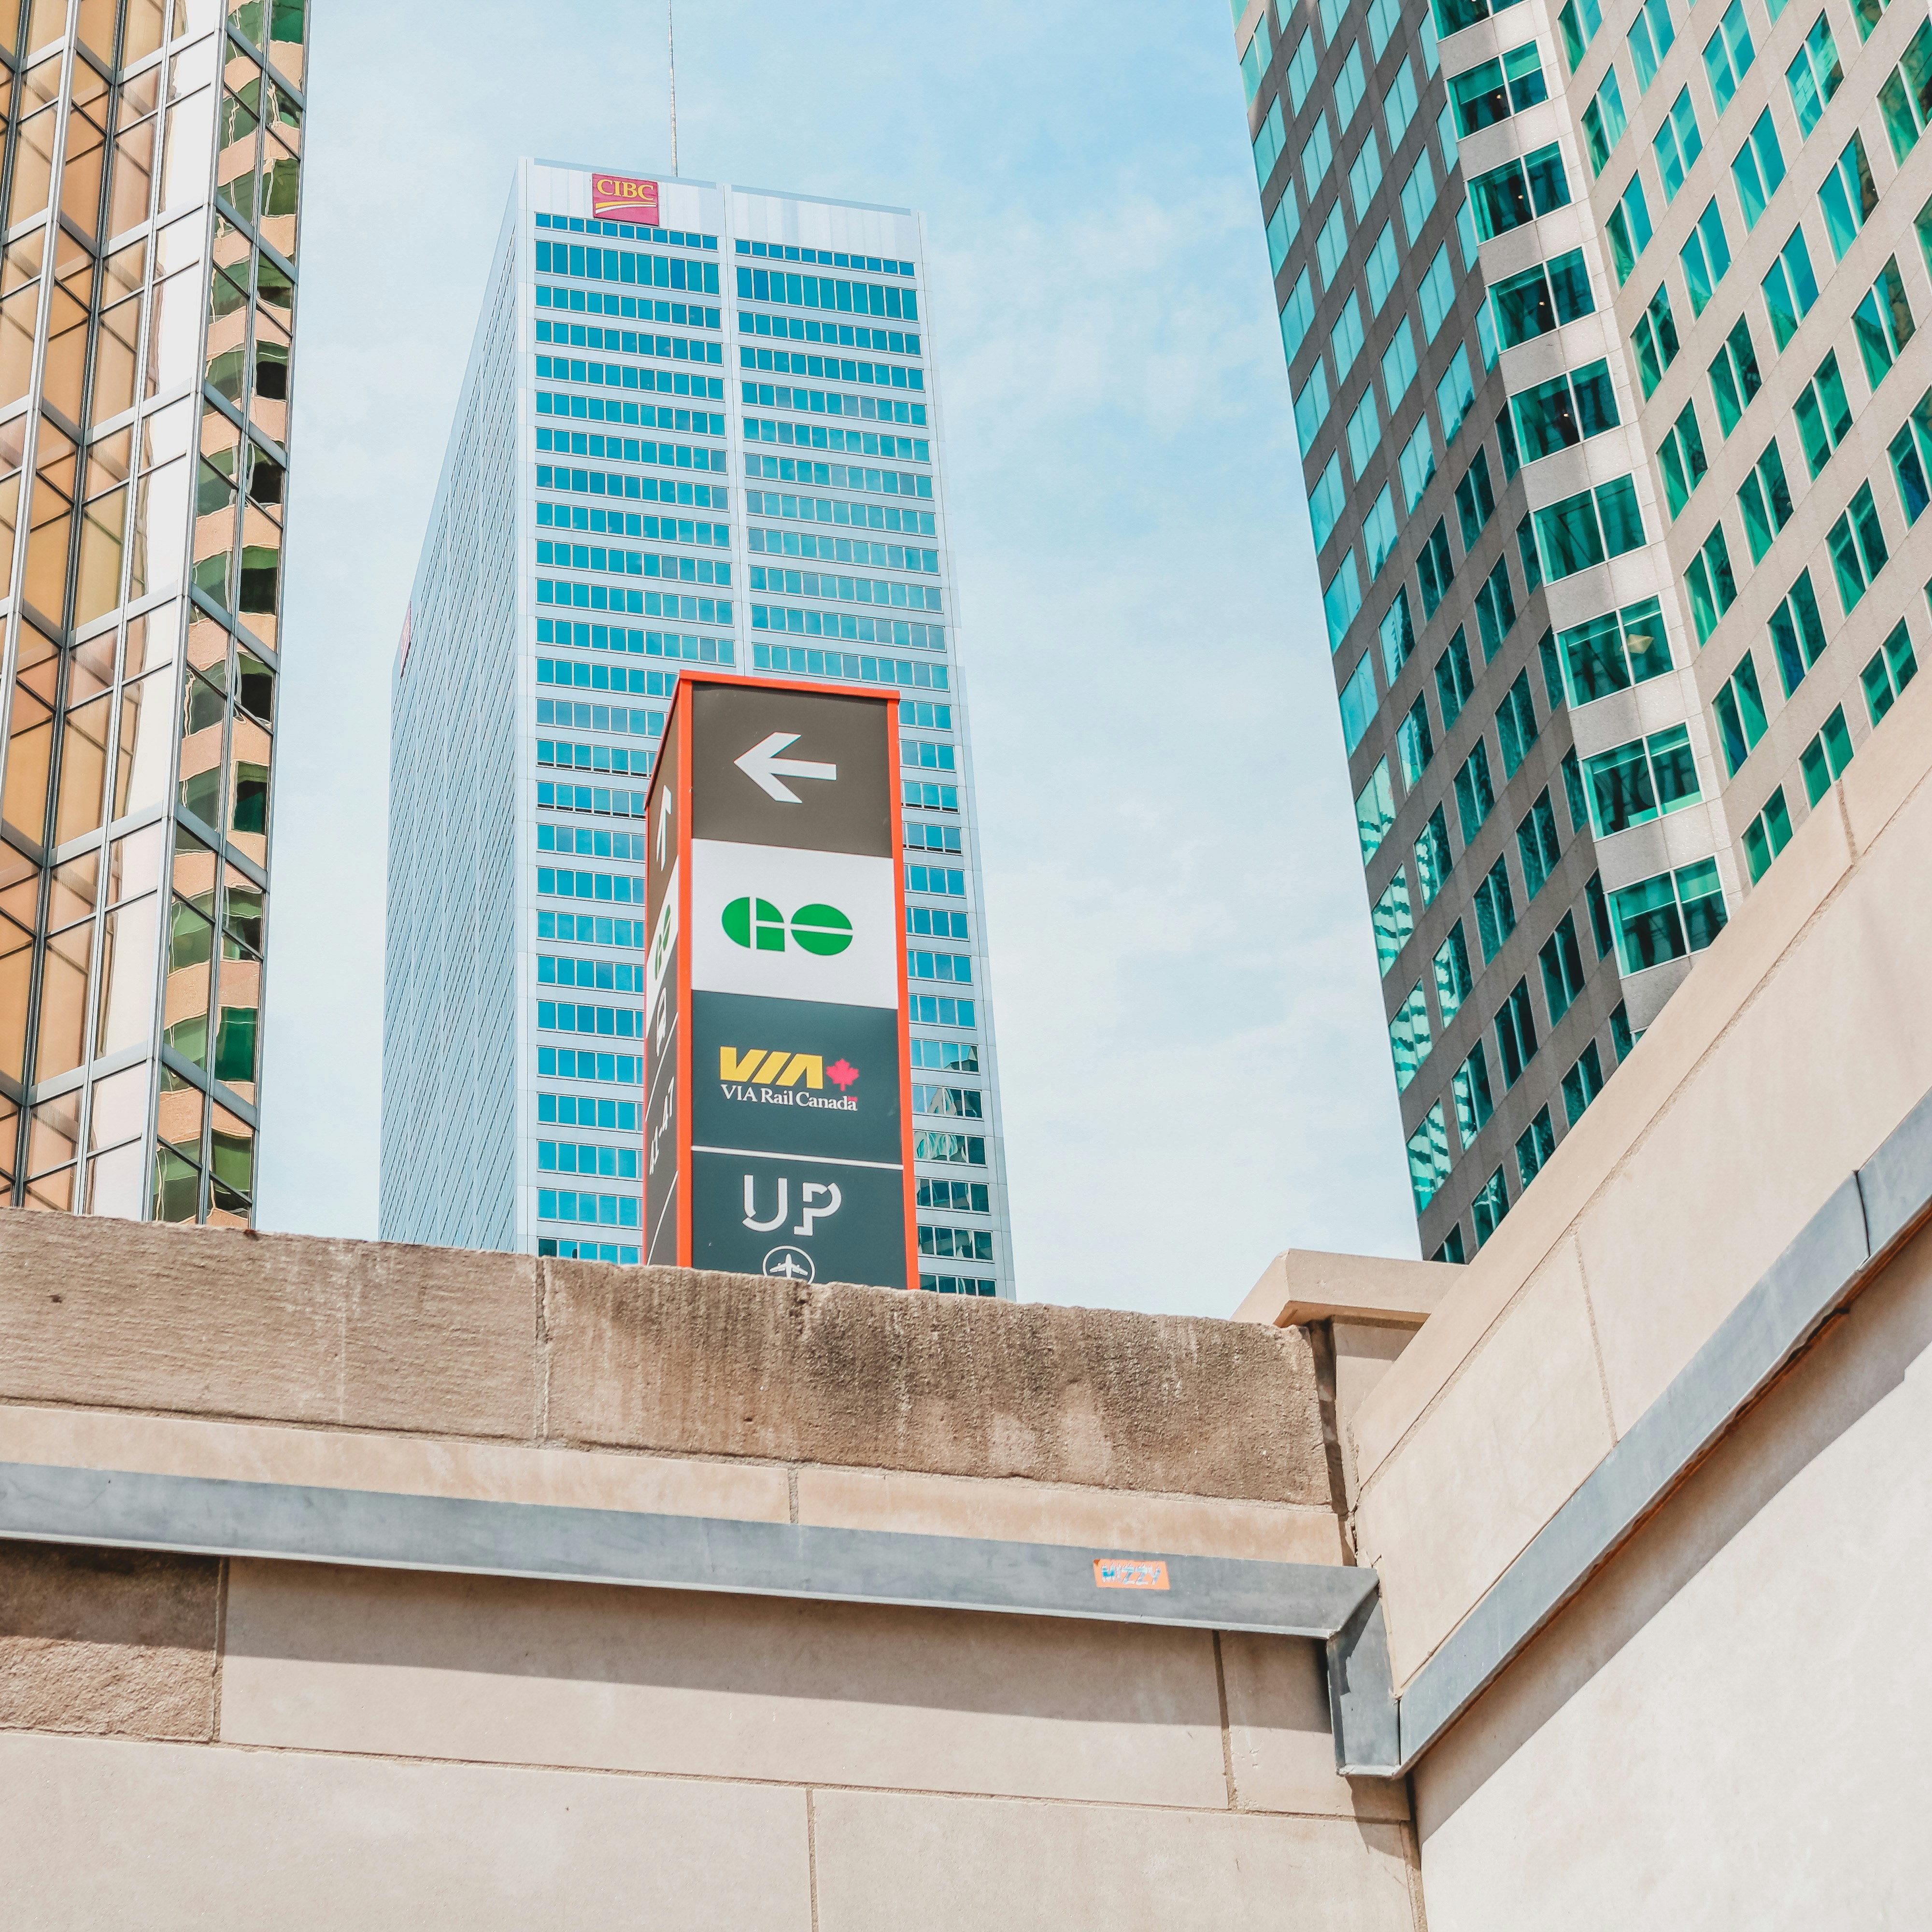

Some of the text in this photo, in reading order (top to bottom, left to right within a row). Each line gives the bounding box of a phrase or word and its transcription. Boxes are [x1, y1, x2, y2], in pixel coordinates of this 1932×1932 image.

[597, 179, 654, 200] CIBC
[722, 896, 853, 956] GO
[719, 1046, 824, 1090] VIA
[721, 1084, 858, 1111] VIA Rail Canada
[742, 1174, 842, 1236] UP
